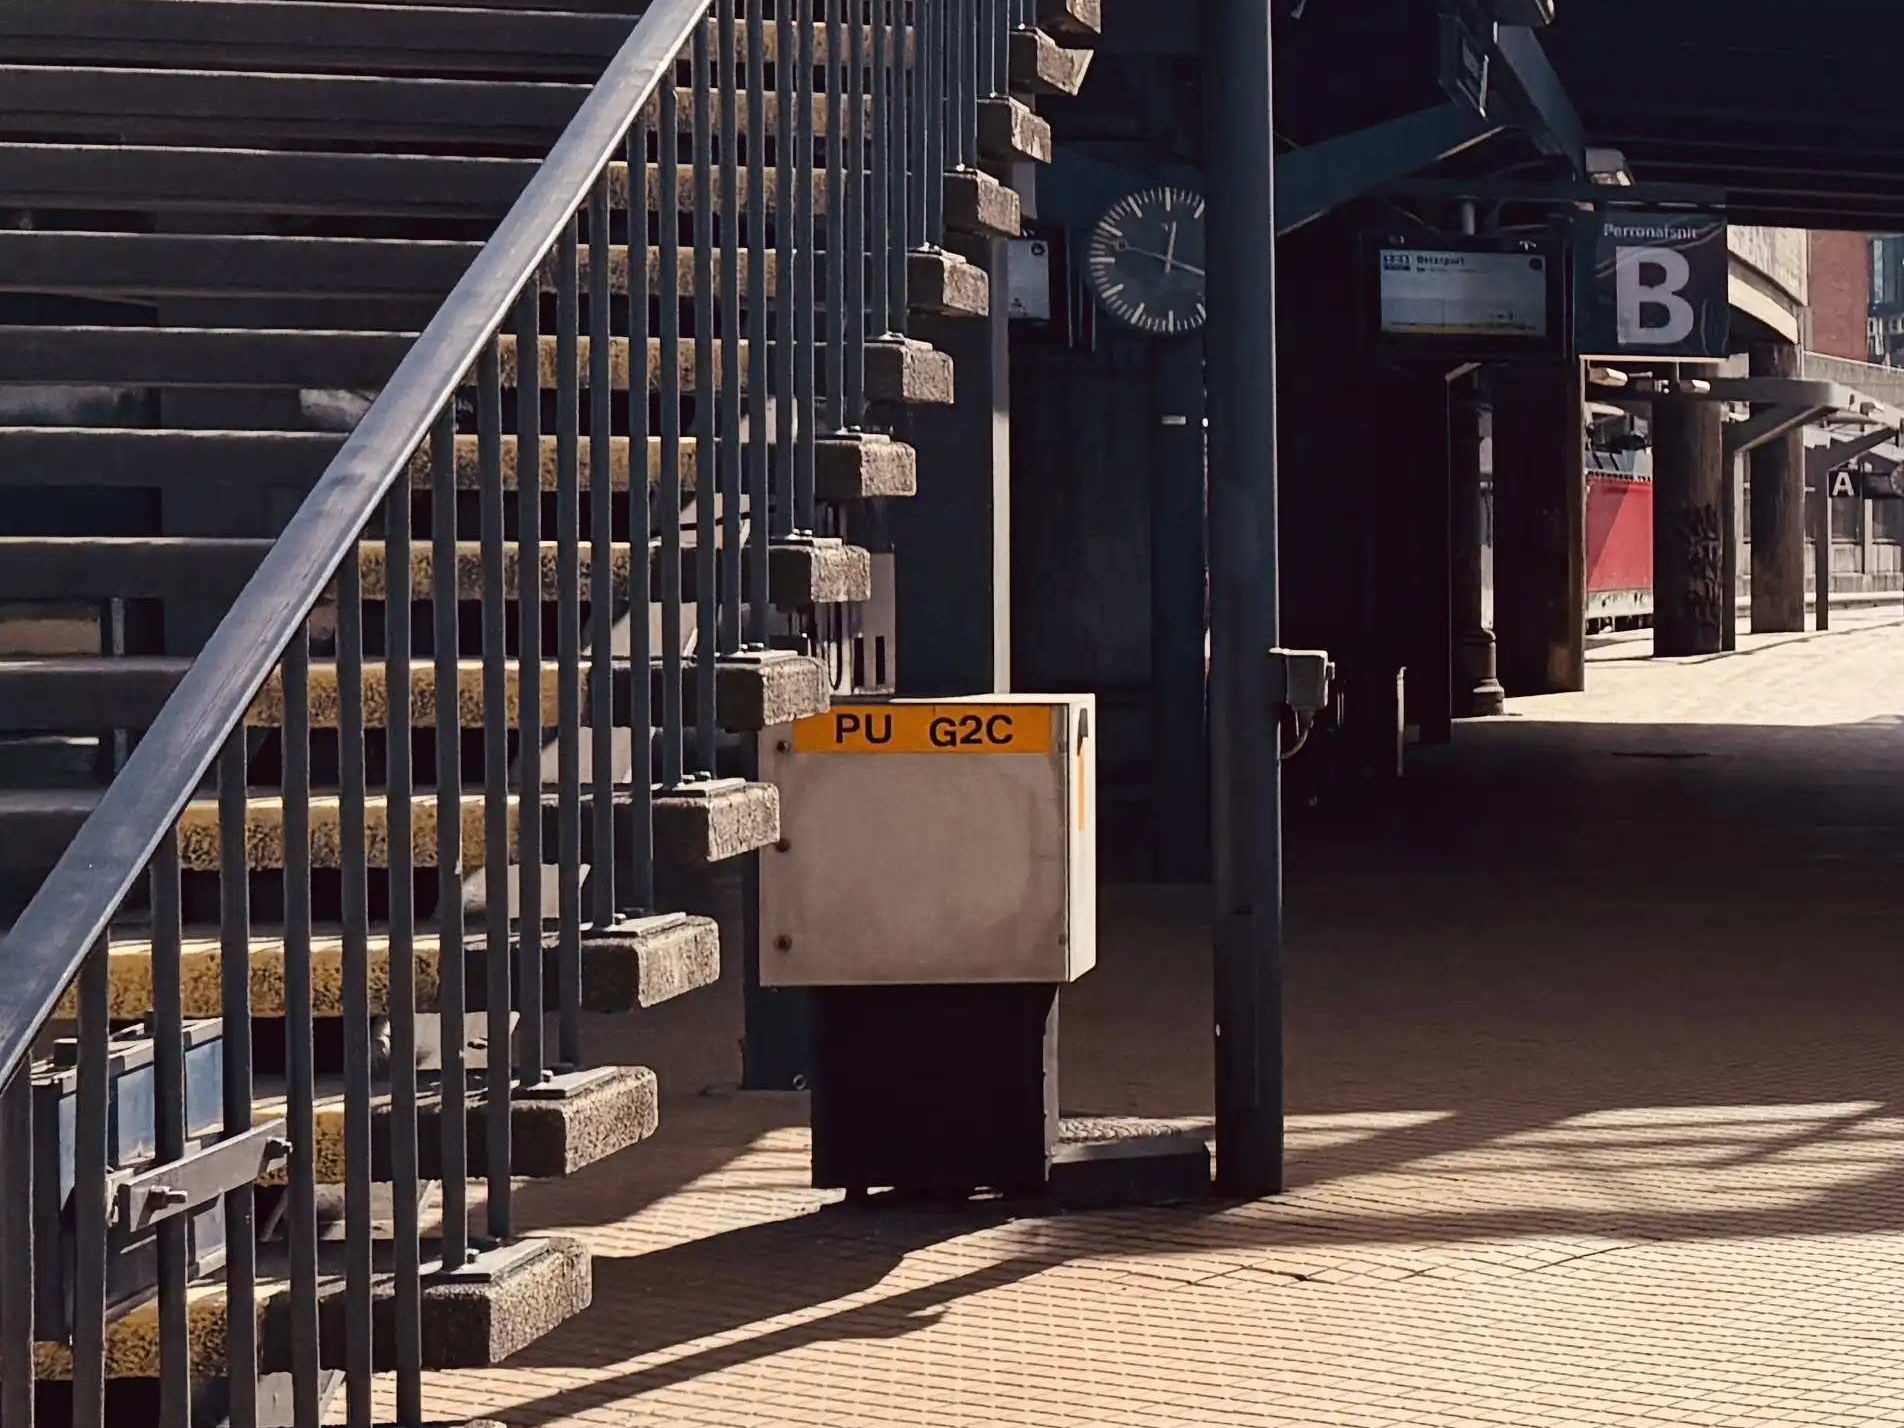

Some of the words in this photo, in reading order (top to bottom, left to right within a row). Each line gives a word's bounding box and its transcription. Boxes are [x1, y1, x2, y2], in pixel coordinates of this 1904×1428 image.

[1616, 246, 1695, 344] B
[1831, 471, 1855, 497] A
[835, 714, 893, 744] PU
[929, 714, 1014, 747] G2C
